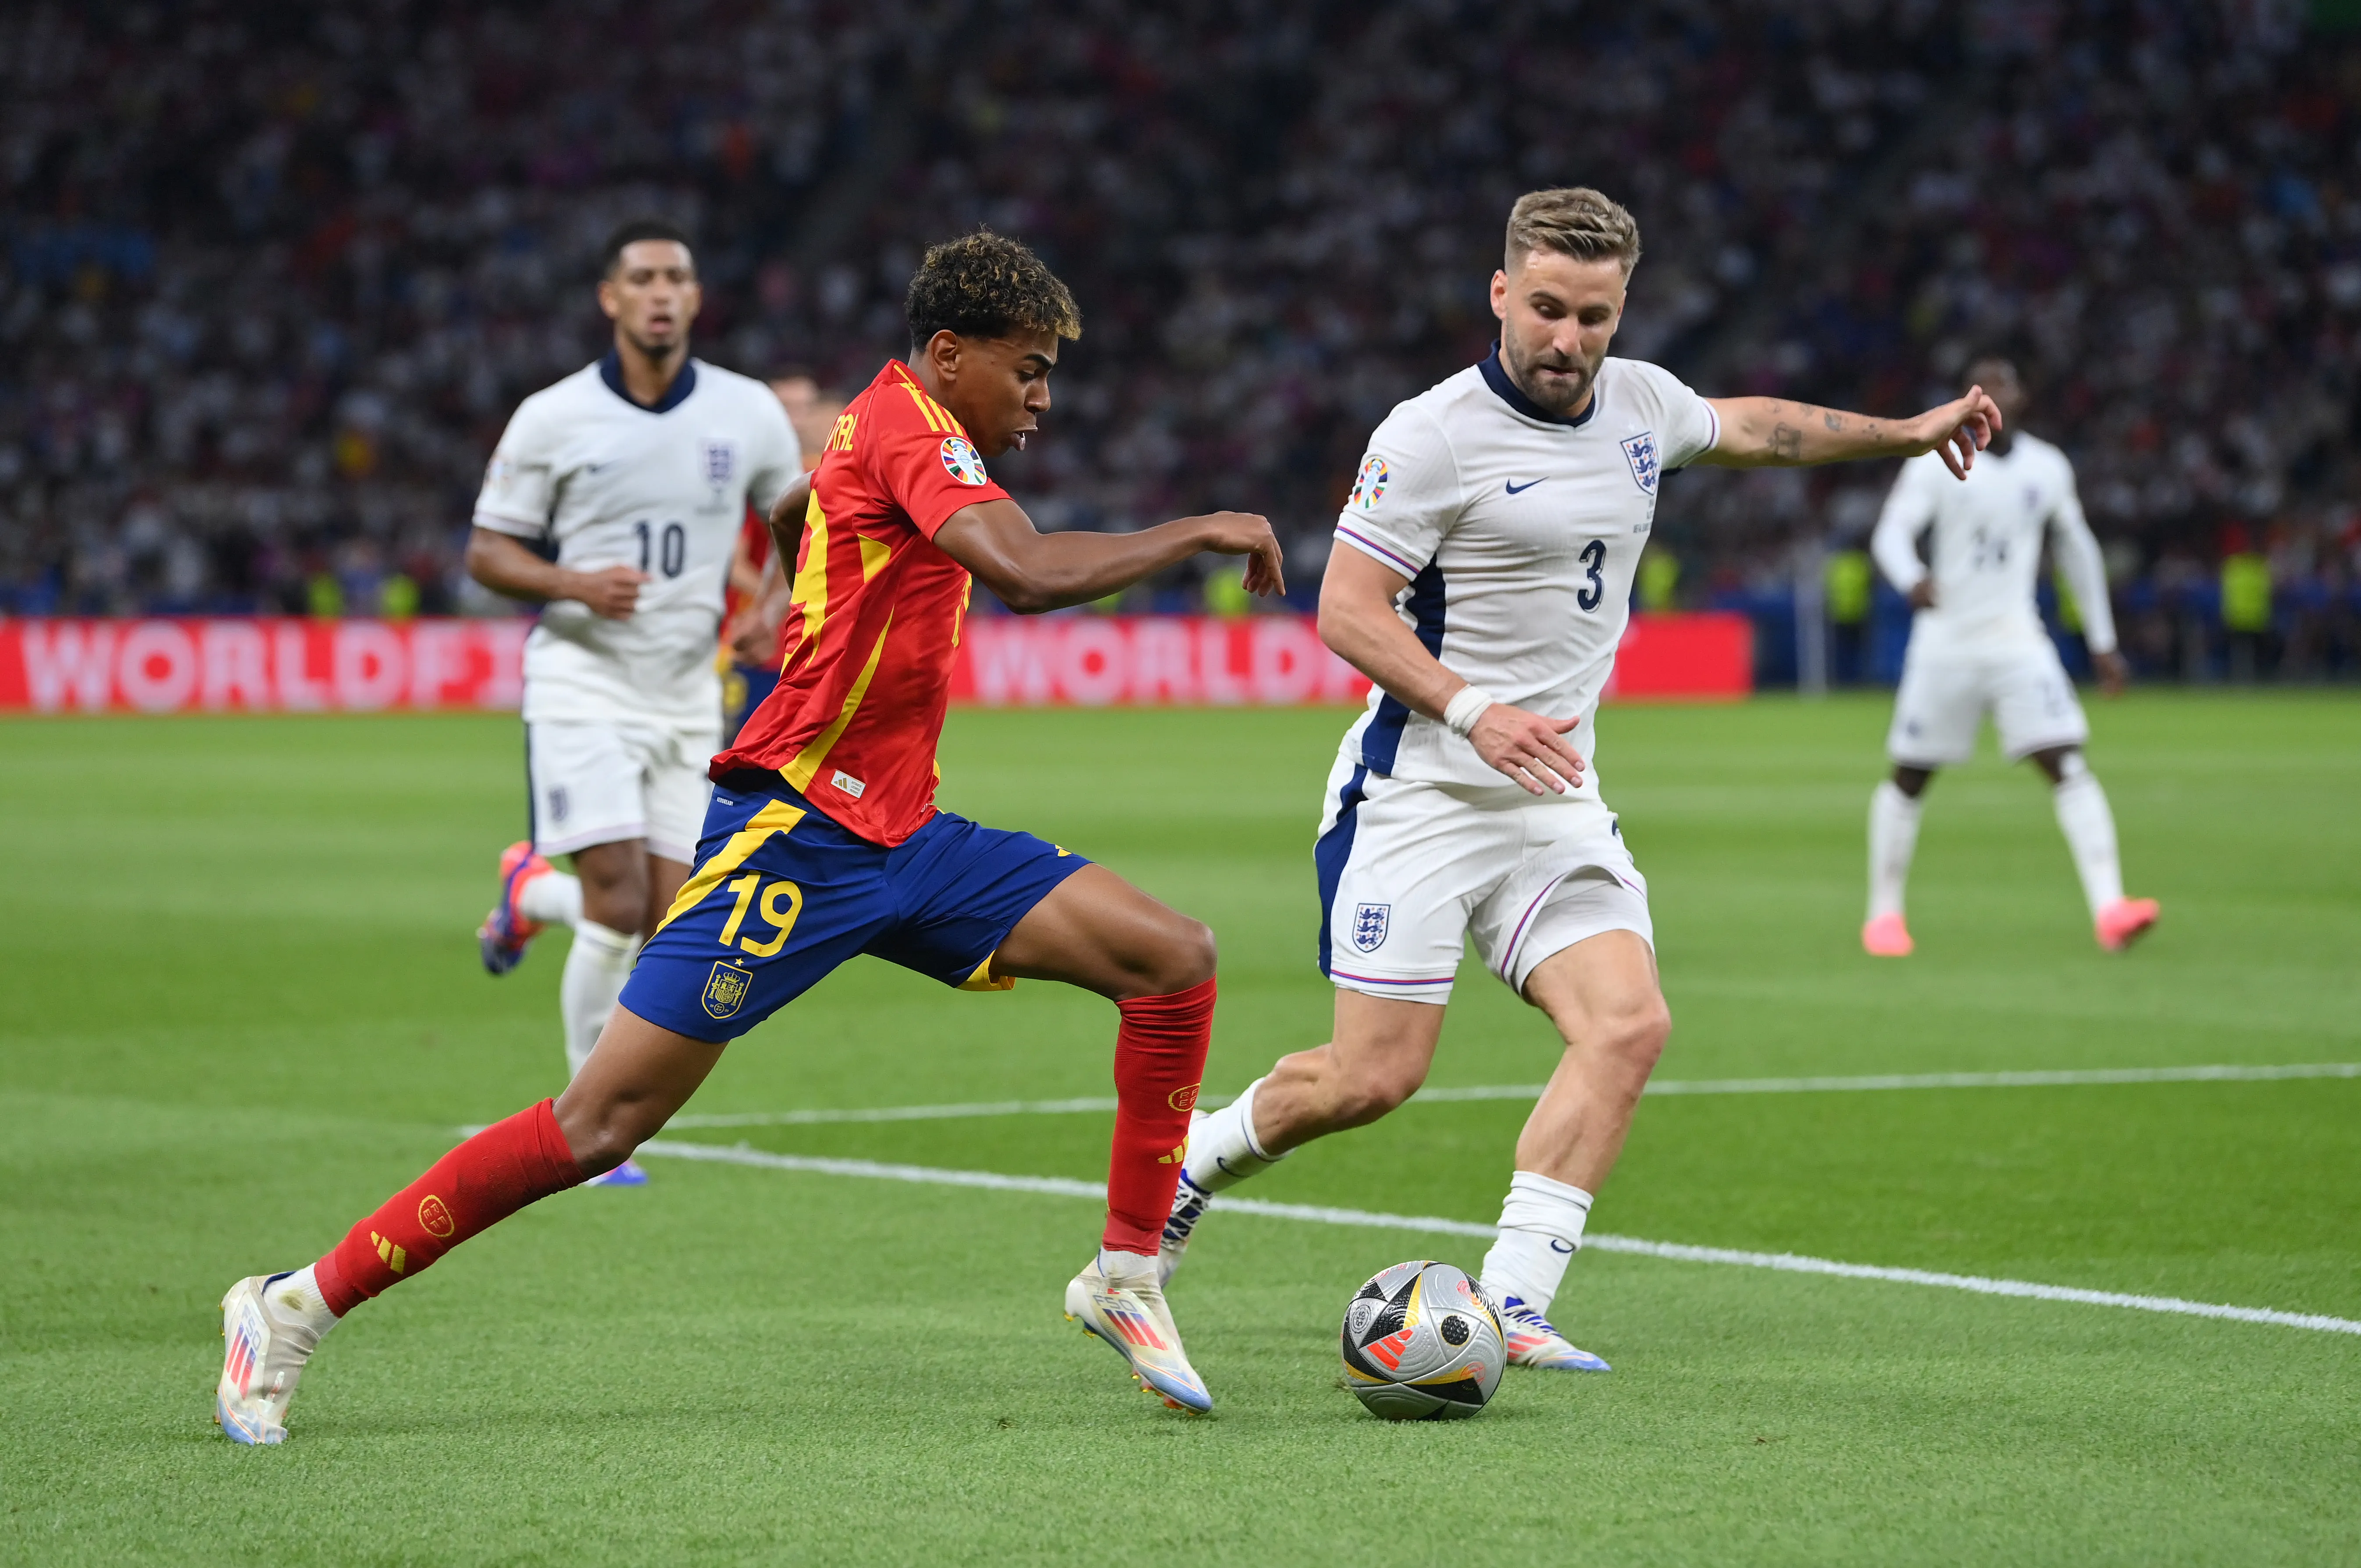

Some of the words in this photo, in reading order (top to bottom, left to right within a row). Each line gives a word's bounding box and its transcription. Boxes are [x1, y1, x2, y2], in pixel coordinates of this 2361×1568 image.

[633, 520, 684, 580] 10
[1577, 539, 1607, 613] 3
[718, 870, 803, 957] 19
